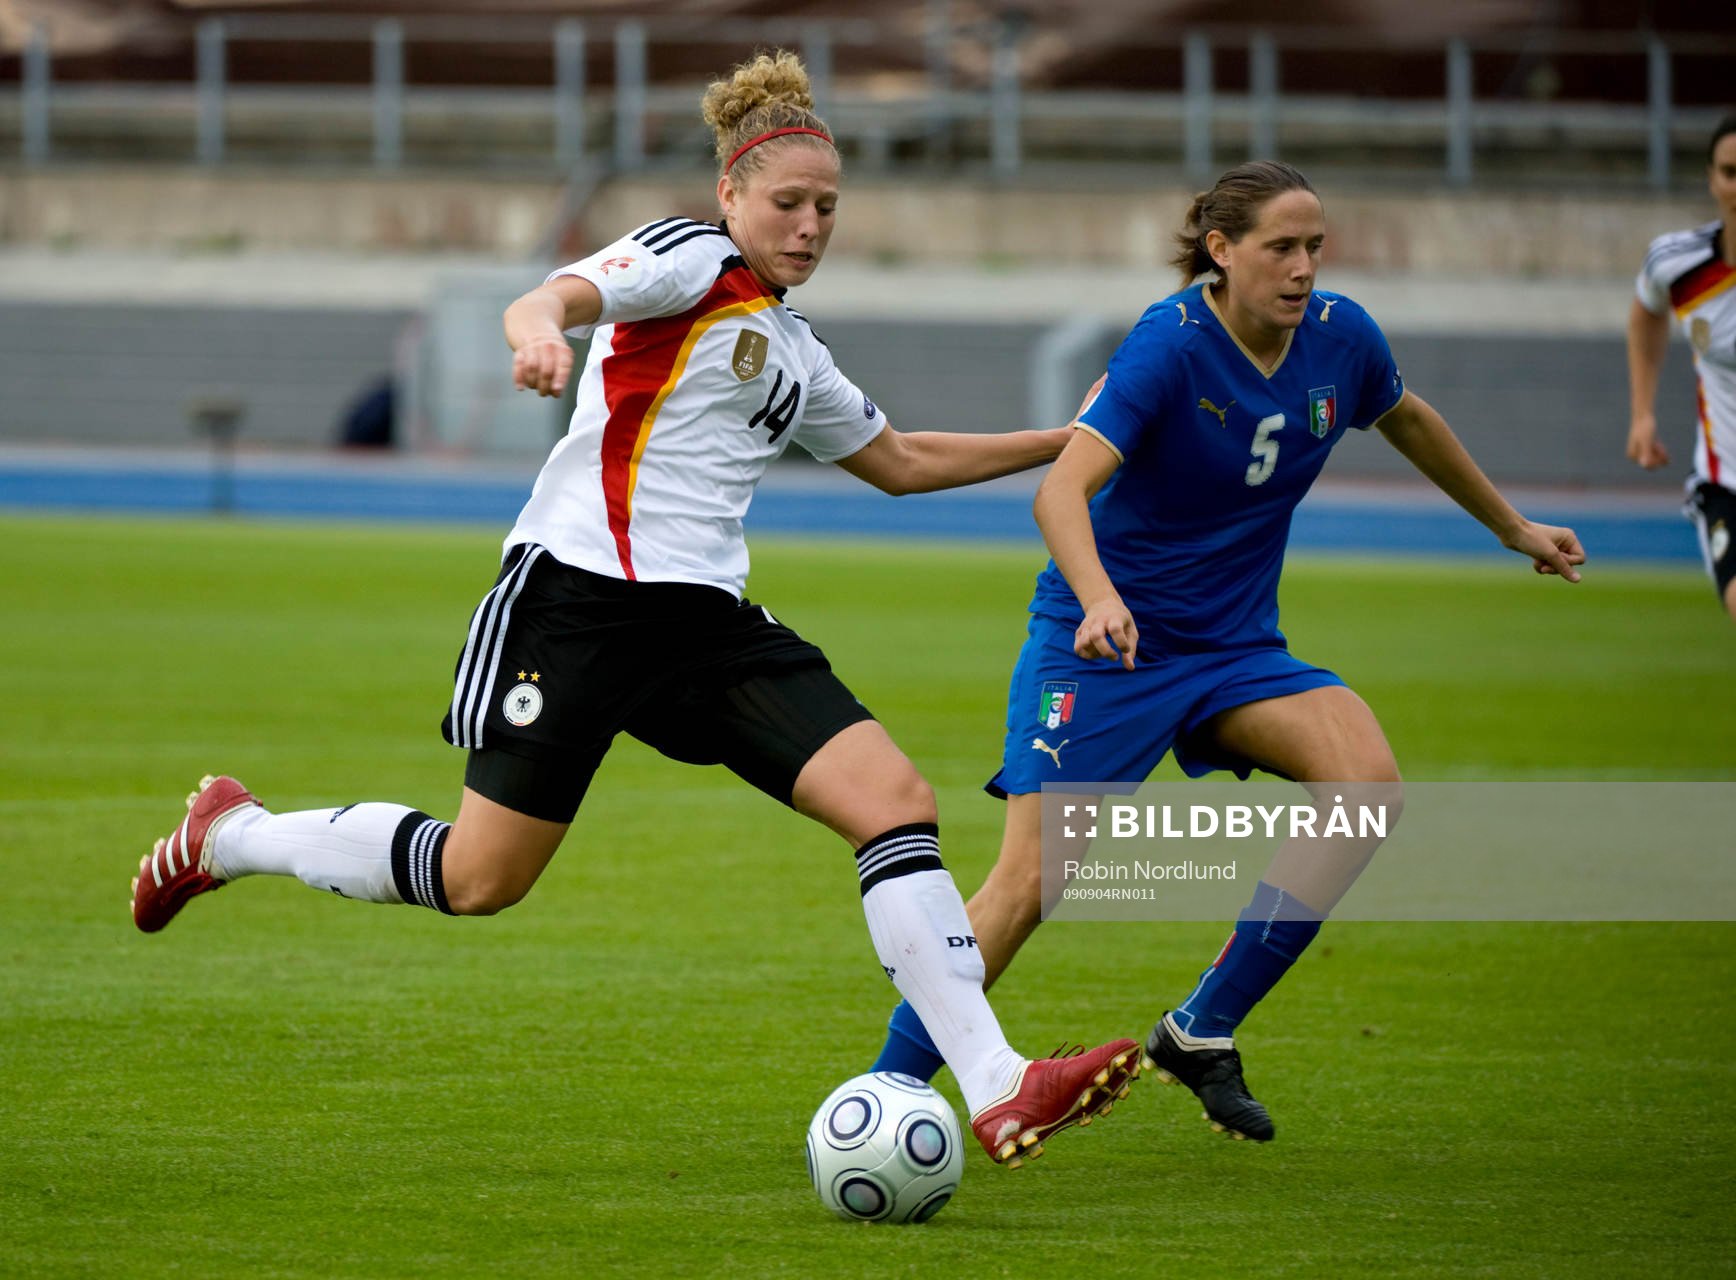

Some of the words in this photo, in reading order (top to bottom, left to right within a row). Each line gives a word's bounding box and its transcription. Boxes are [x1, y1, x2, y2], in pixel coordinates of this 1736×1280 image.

[738, 361, 754, 372] FIFA
[748, 369, 801, 445] 14
[1244, 412, 1286, 487] 5
